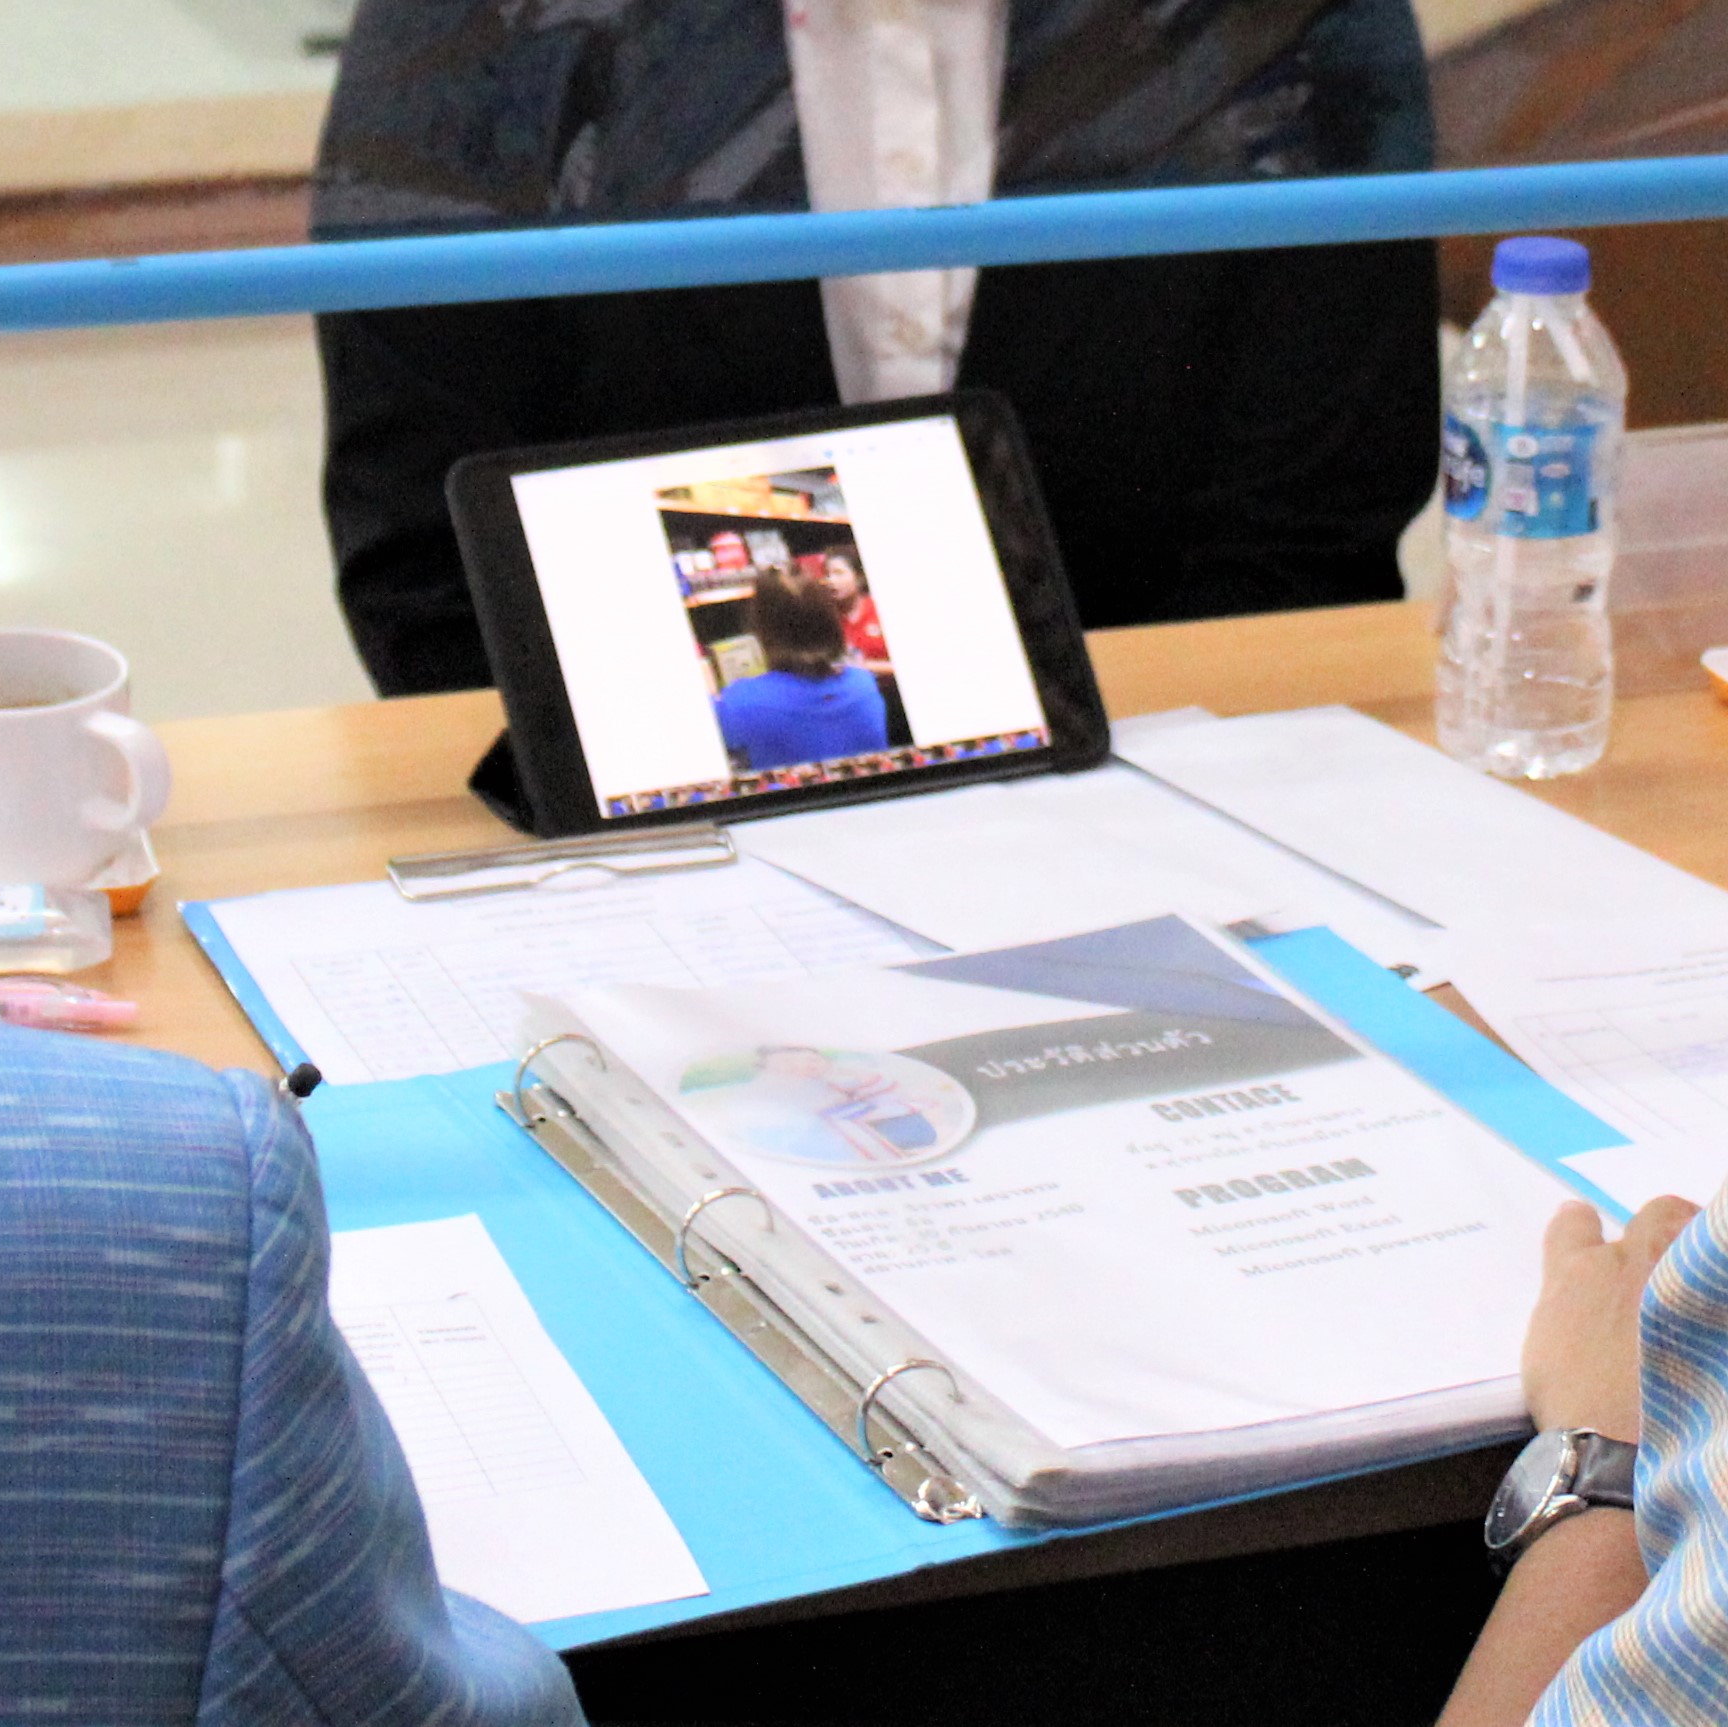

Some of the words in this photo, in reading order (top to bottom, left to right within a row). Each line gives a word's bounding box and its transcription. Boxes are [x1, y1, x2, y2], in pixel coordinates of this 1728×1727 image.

[976, 1028, 1213, 1079] ประวัติส่วนตัว
[811, 1174, 917, 1201] ABOUT
[918, 1166, 971, 1188] ME
[1171, 1156, 1378, 1209] PROGRAM
[1312, 1194, 1376, 1217] Word
[1338, 1212, 1403, 1236] Excel
[1367, 1220, 1489, 1256] powerpoint
